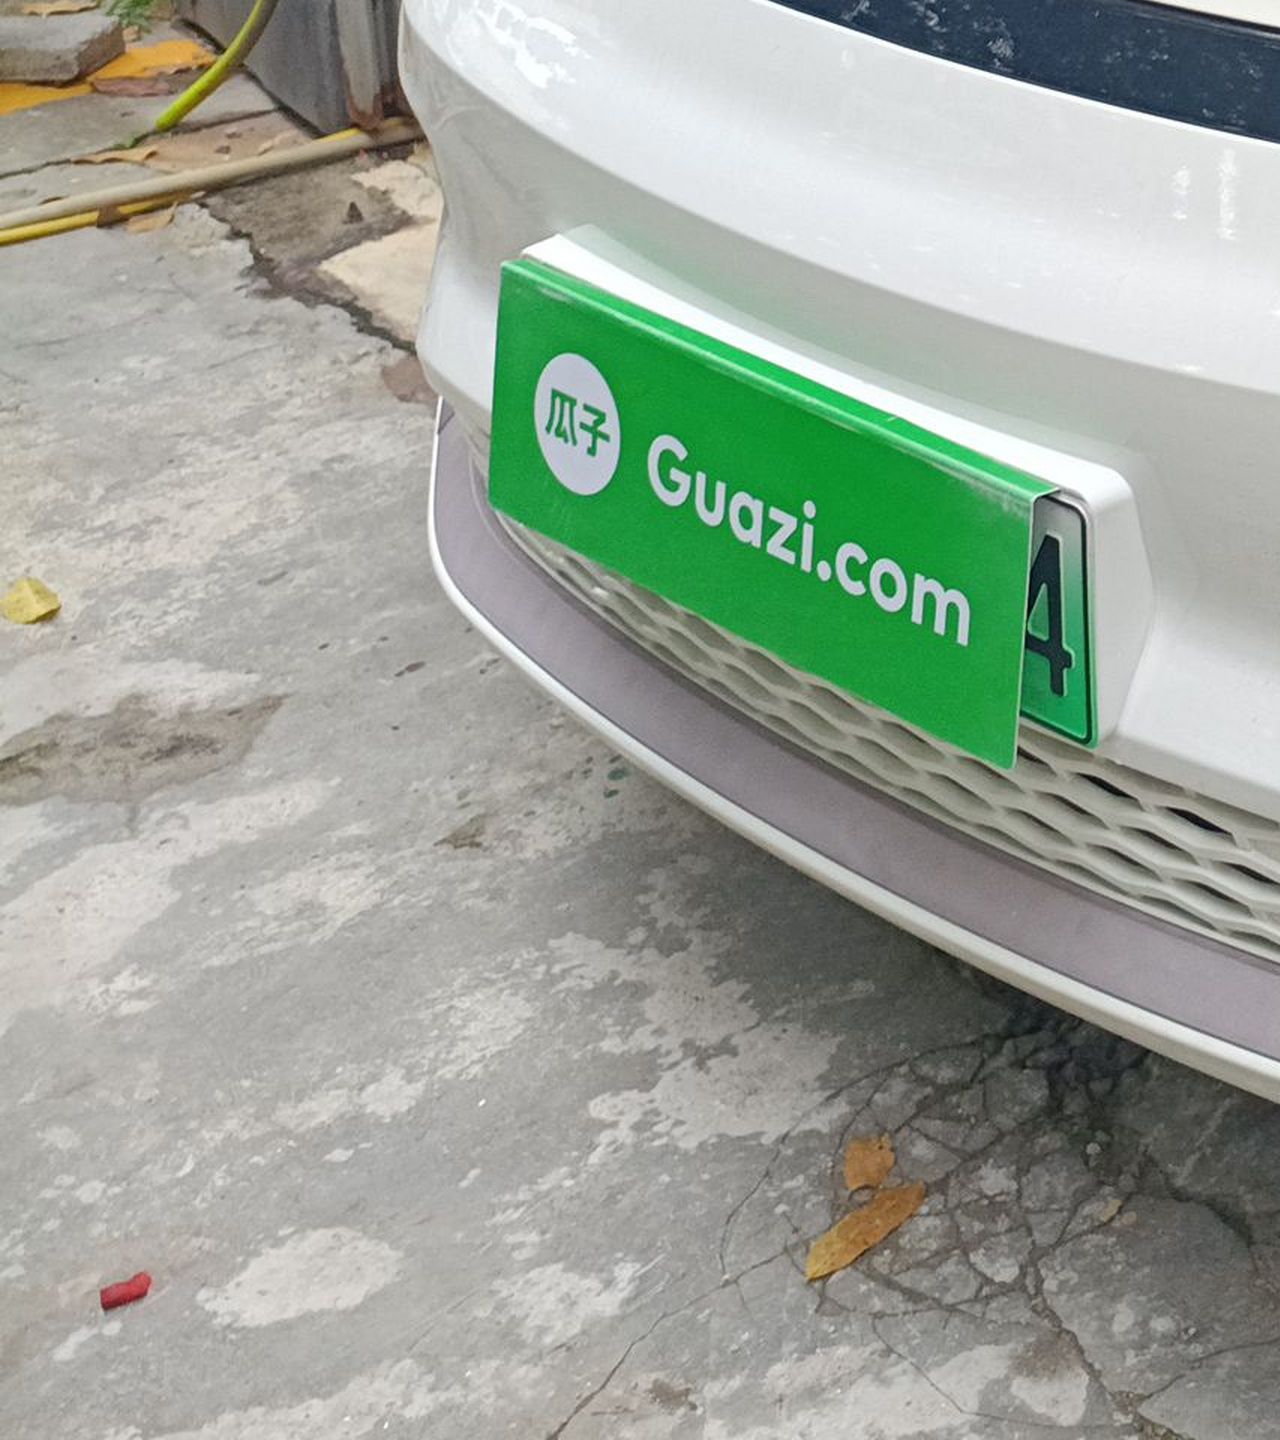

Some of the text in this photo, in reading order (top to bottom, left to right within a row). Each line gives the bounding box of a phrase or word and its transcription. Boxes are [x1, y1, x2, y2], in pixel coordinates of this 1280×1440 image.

[546, 388, 611, 457] 瓜子
[647, 434, 971, 646] Guazi.com
[1025, 534, 1073, 697] 4
